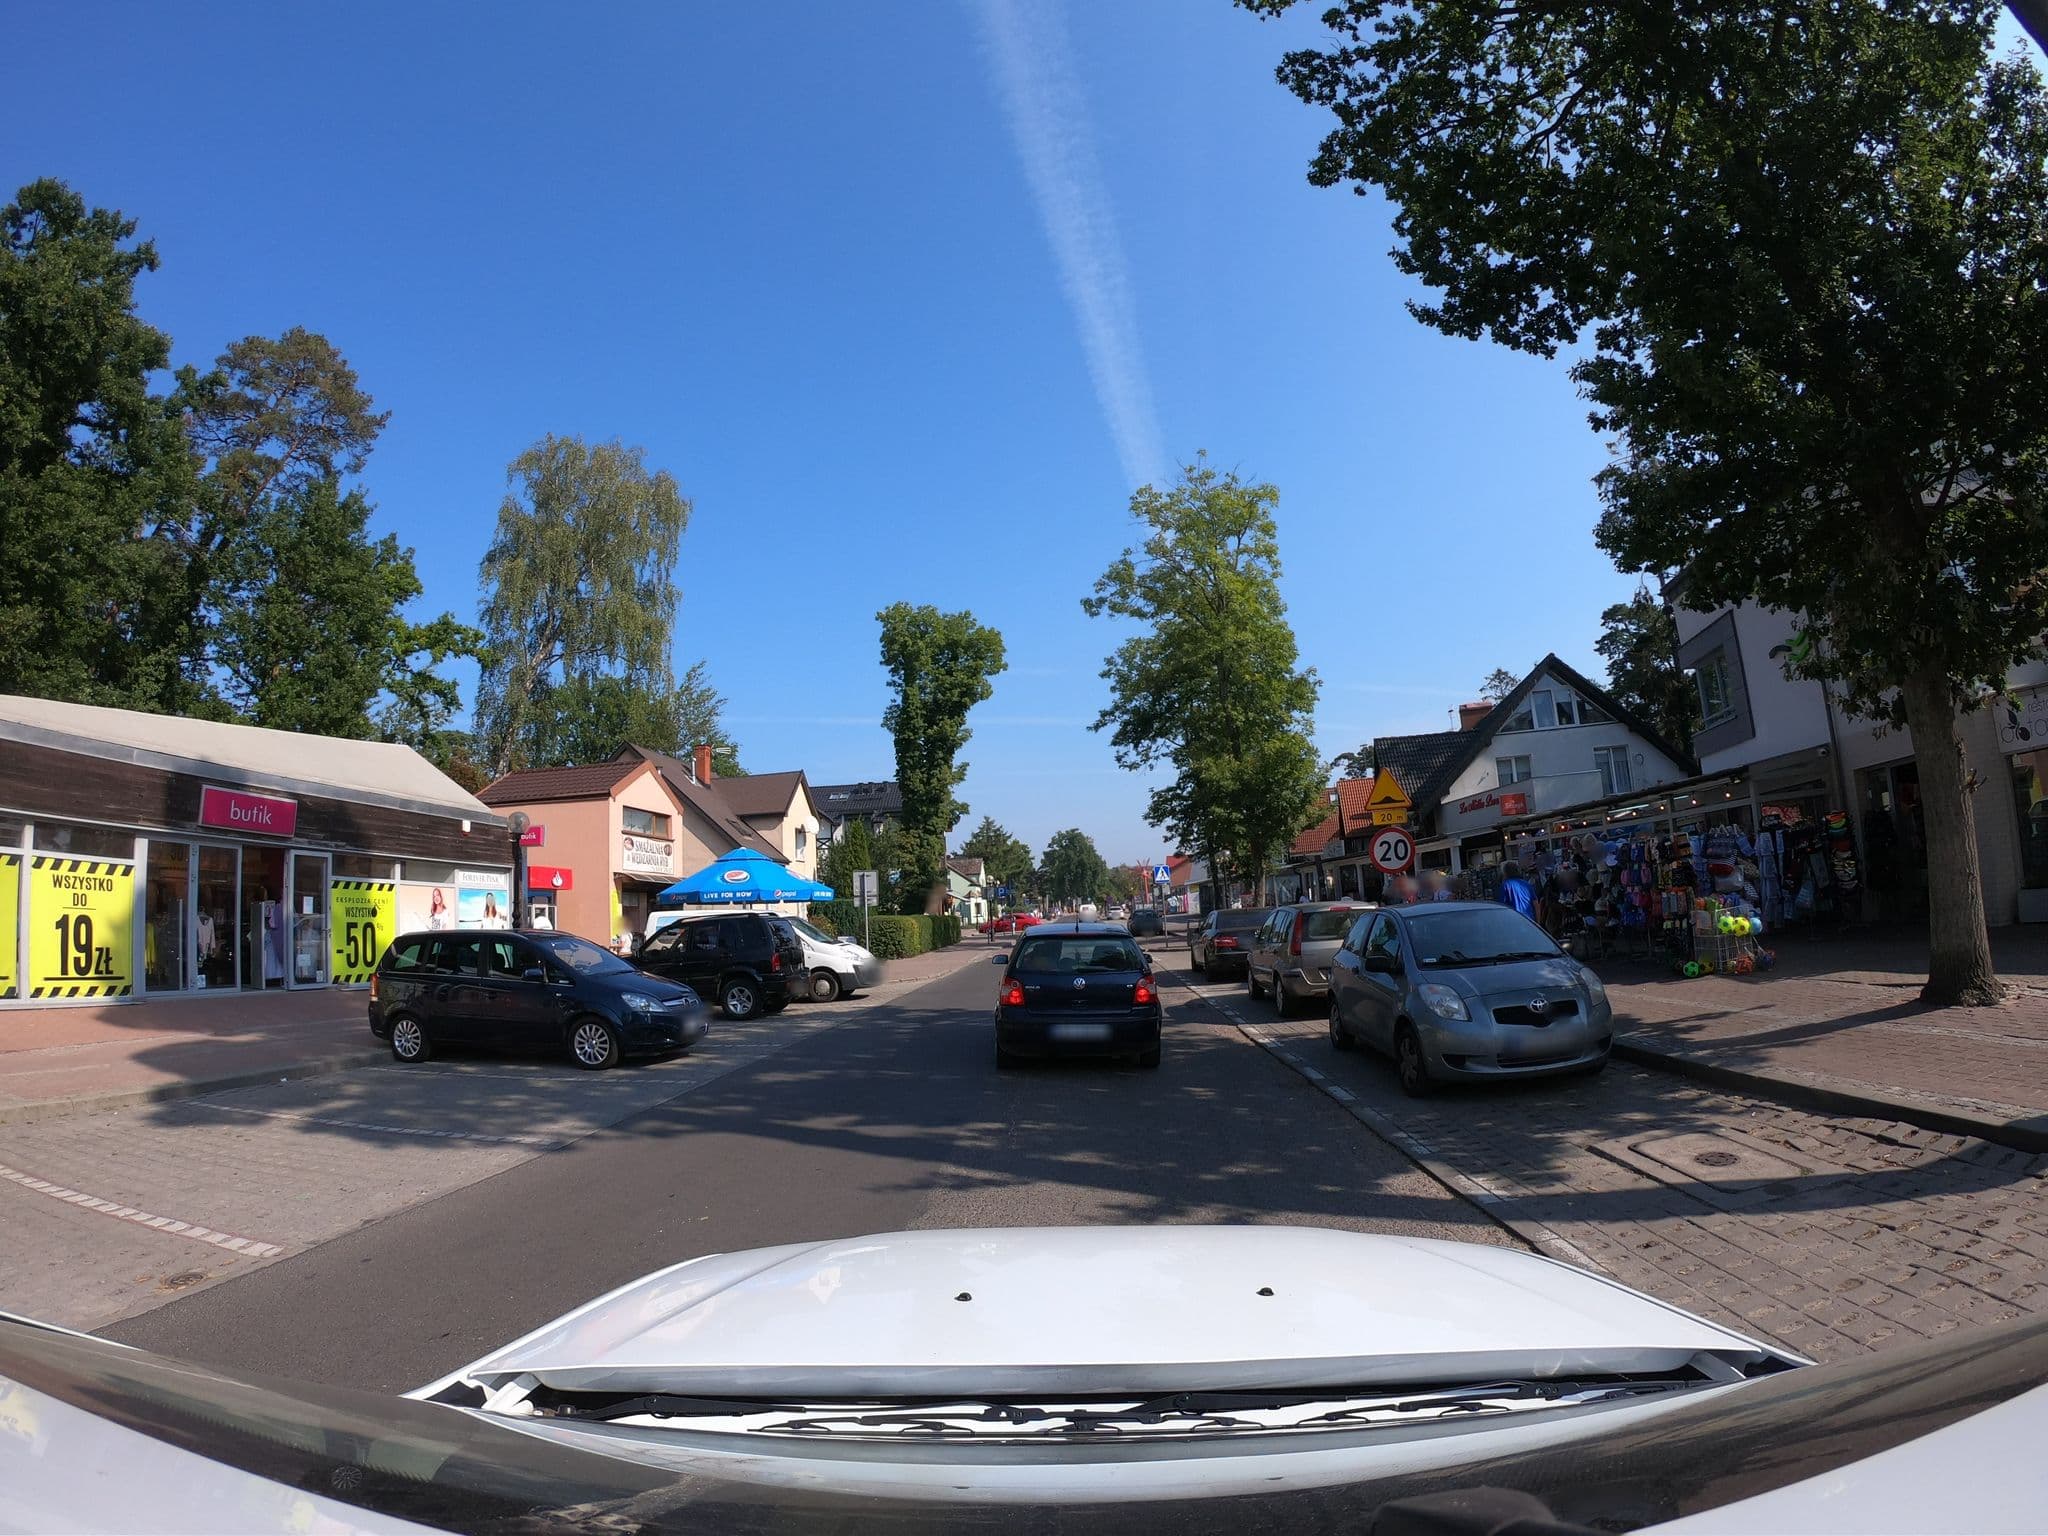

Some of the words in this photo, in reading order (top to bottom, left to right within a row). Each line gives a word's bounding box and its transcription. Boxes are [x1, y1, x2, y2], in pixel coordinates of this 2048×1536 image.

[230, 800, 272, 825] butik
[1381, 813, 1392, 822] 20
[1379, 839, 1409, 862] 20
[52, 874, 113, 892] WSZYSTKO
[72, 893, 87, 907] DO
[782, 890, 797, 898] pepsi
